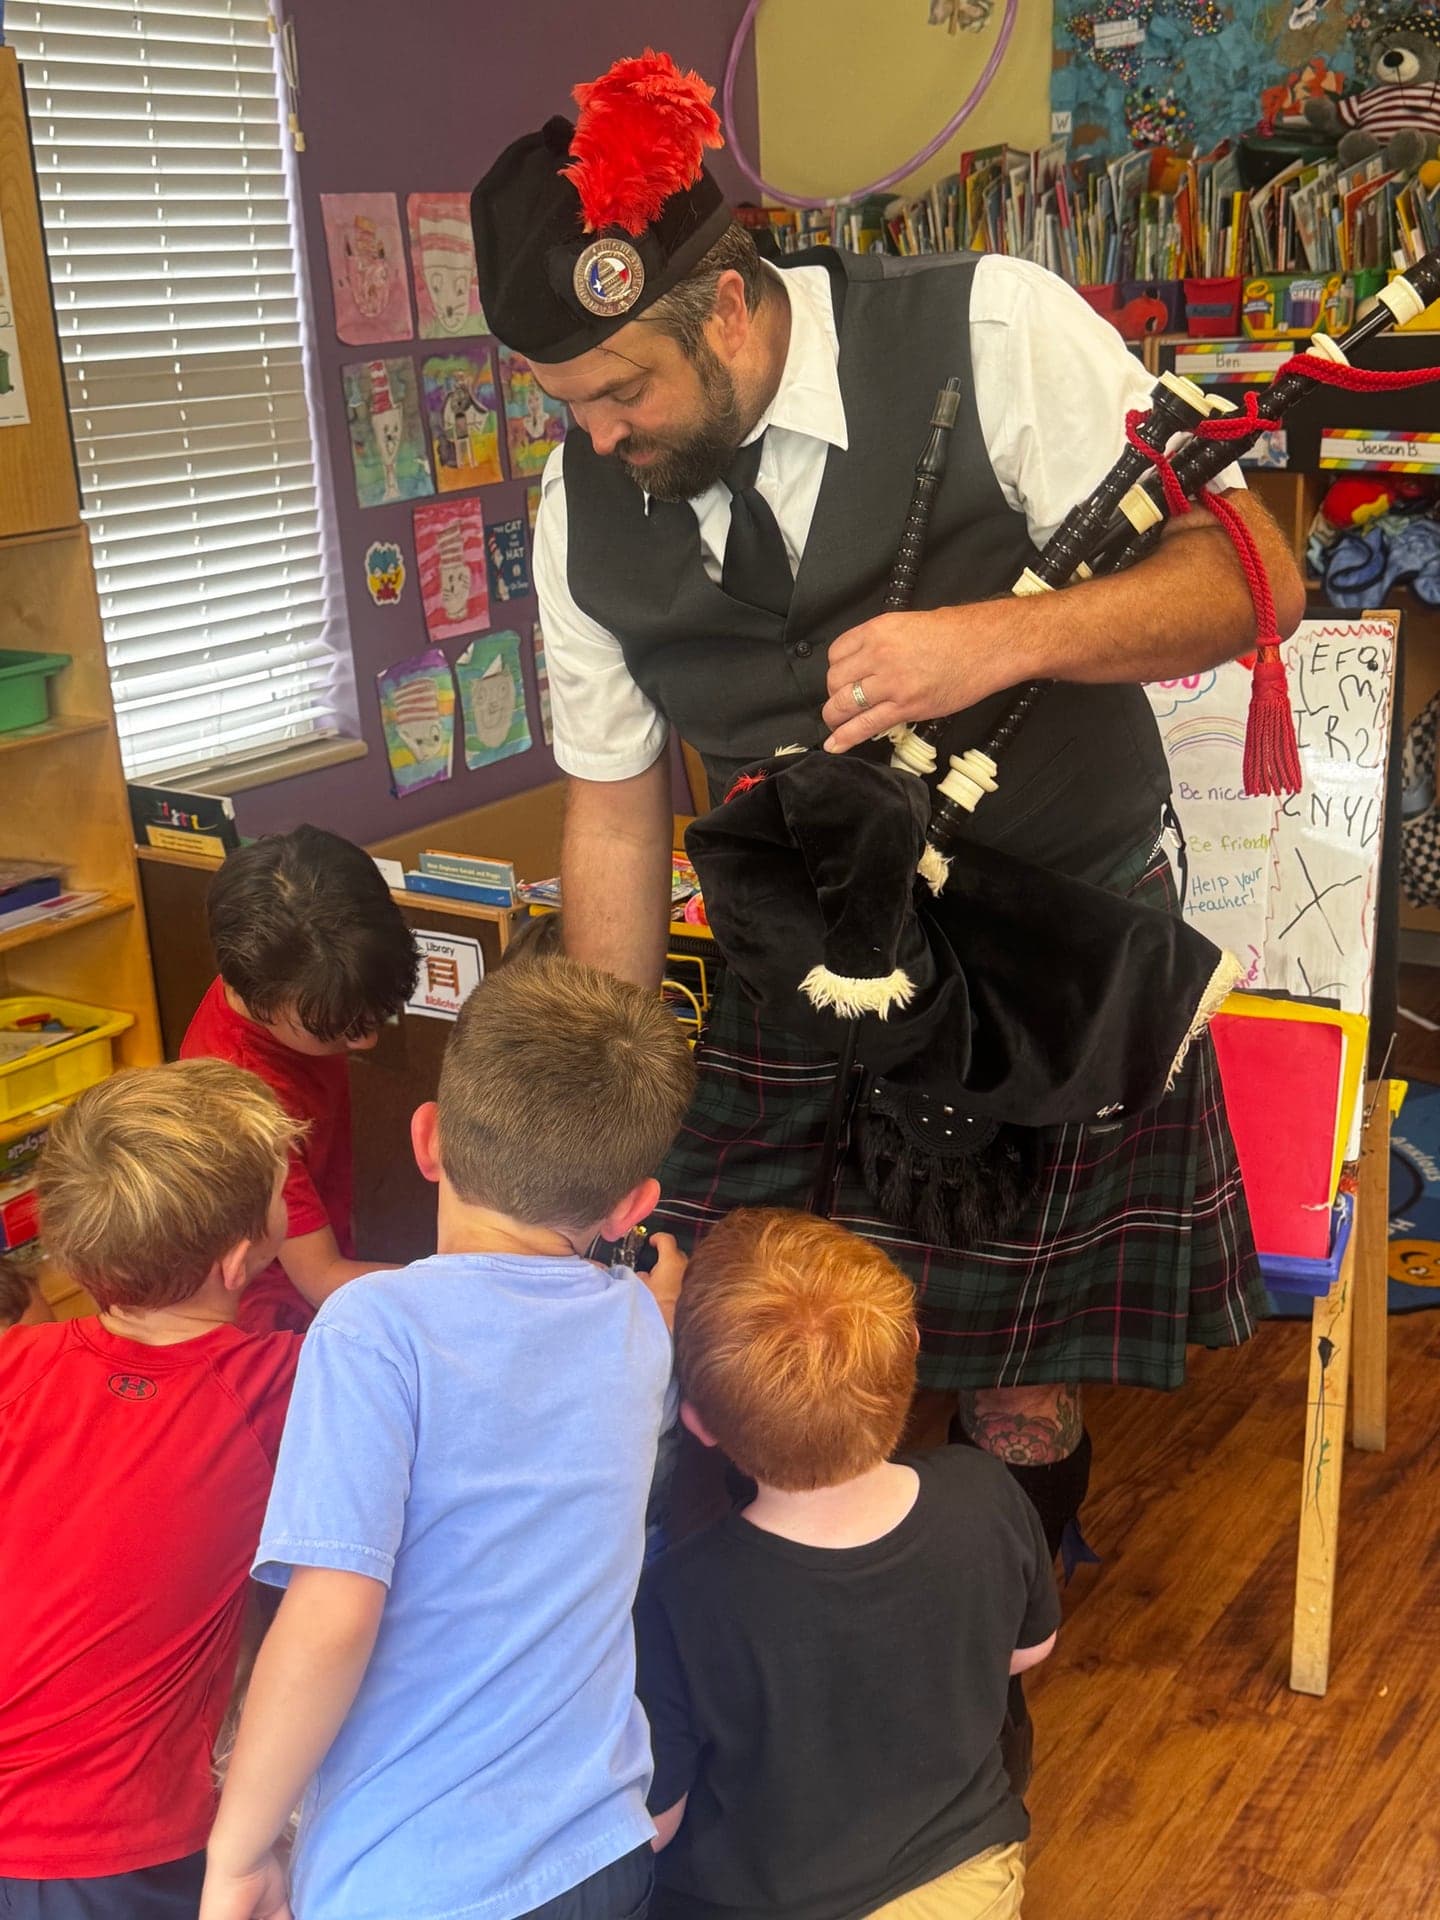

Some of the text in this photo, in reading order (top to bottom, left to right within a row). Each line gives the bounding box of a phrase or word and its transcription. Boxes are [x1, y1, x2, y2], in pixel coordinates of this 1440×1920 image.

[1055, 115, 1069, 130] W
[1215, 351, 1240, 369] Ben
[1356, 439, 1405, 457] Jackson
[505, 519, 522, 534] CAT
[506, 547, 524, 561] HAT
[1178, 780, 1203, 801] Be
[1188, 834, 1213, 853] Be
[1191, 874, 1230, 898] Help
[1184, 886, 1257, 917] teacher!
[425, 941, 456, 958] Library
